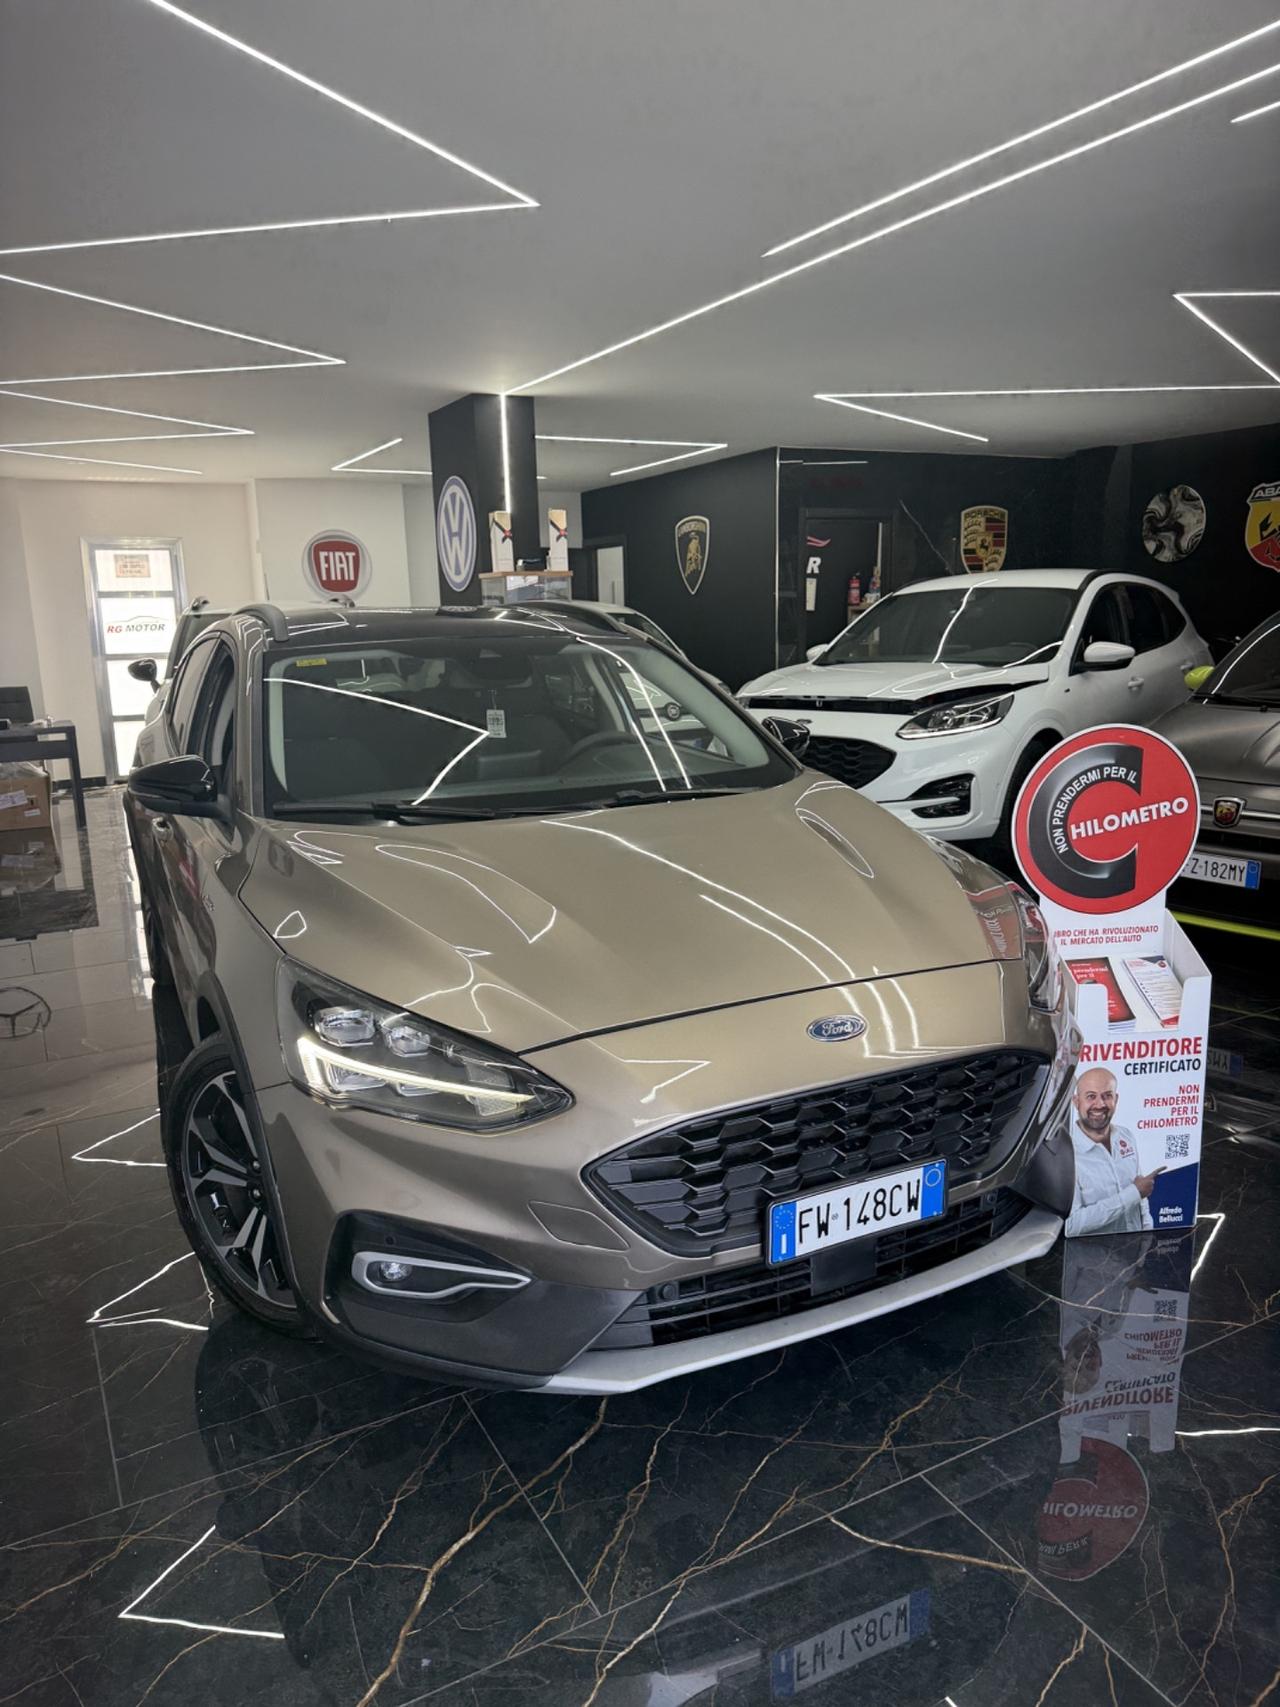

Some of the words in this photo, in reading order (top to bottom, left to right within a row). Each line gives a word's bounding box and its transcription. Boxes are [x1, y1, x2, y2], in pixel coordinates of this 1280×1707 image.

[1255, 486, 1280, 498] ABA
[319, 551, 356, 581] FIAT
[107, 625, 123, 634] RG
[125, 623, 166, 633] MOTOR
[1102, 766, 1127, 779] PER
[1127, 770, 1138, 784] IL
[1053, 768, 1101, 829] PRENDERMI
[1070, 796, 1189, 841] HILOMETRO
[1052, 829, 1069, 854] NON
[1203, 860, 1246, 882] 182MY
[1073, 929, 1087, 937] CHE
[1089, 928, 1099, 936] HA
[1102, 925, 1159, 935] RIVOLUZIONATO
[1060, 938, 1067, 946] IL
[1070, 936, 1104, 945] MERCATO
[822, 1020, 854, 1037] Ford
[1079, 1036, 1203, 1062] RIVENDITORE
[1124, 1058, 1201, 1075] CERTIFICATO
[1178, 1084, 1200, 1095] NON
[1143, 1095, 1199, 1108] PRENDERMI
[1170, 1107, 1189, 1116] PER
[1191, 1106, 1199, 1115] IL
[1137, 1116, 1199, 1130] CHILOMETRO
[798, 1202, 831, 1244] FW
[843, 1178, 921, 1231] 148CW
